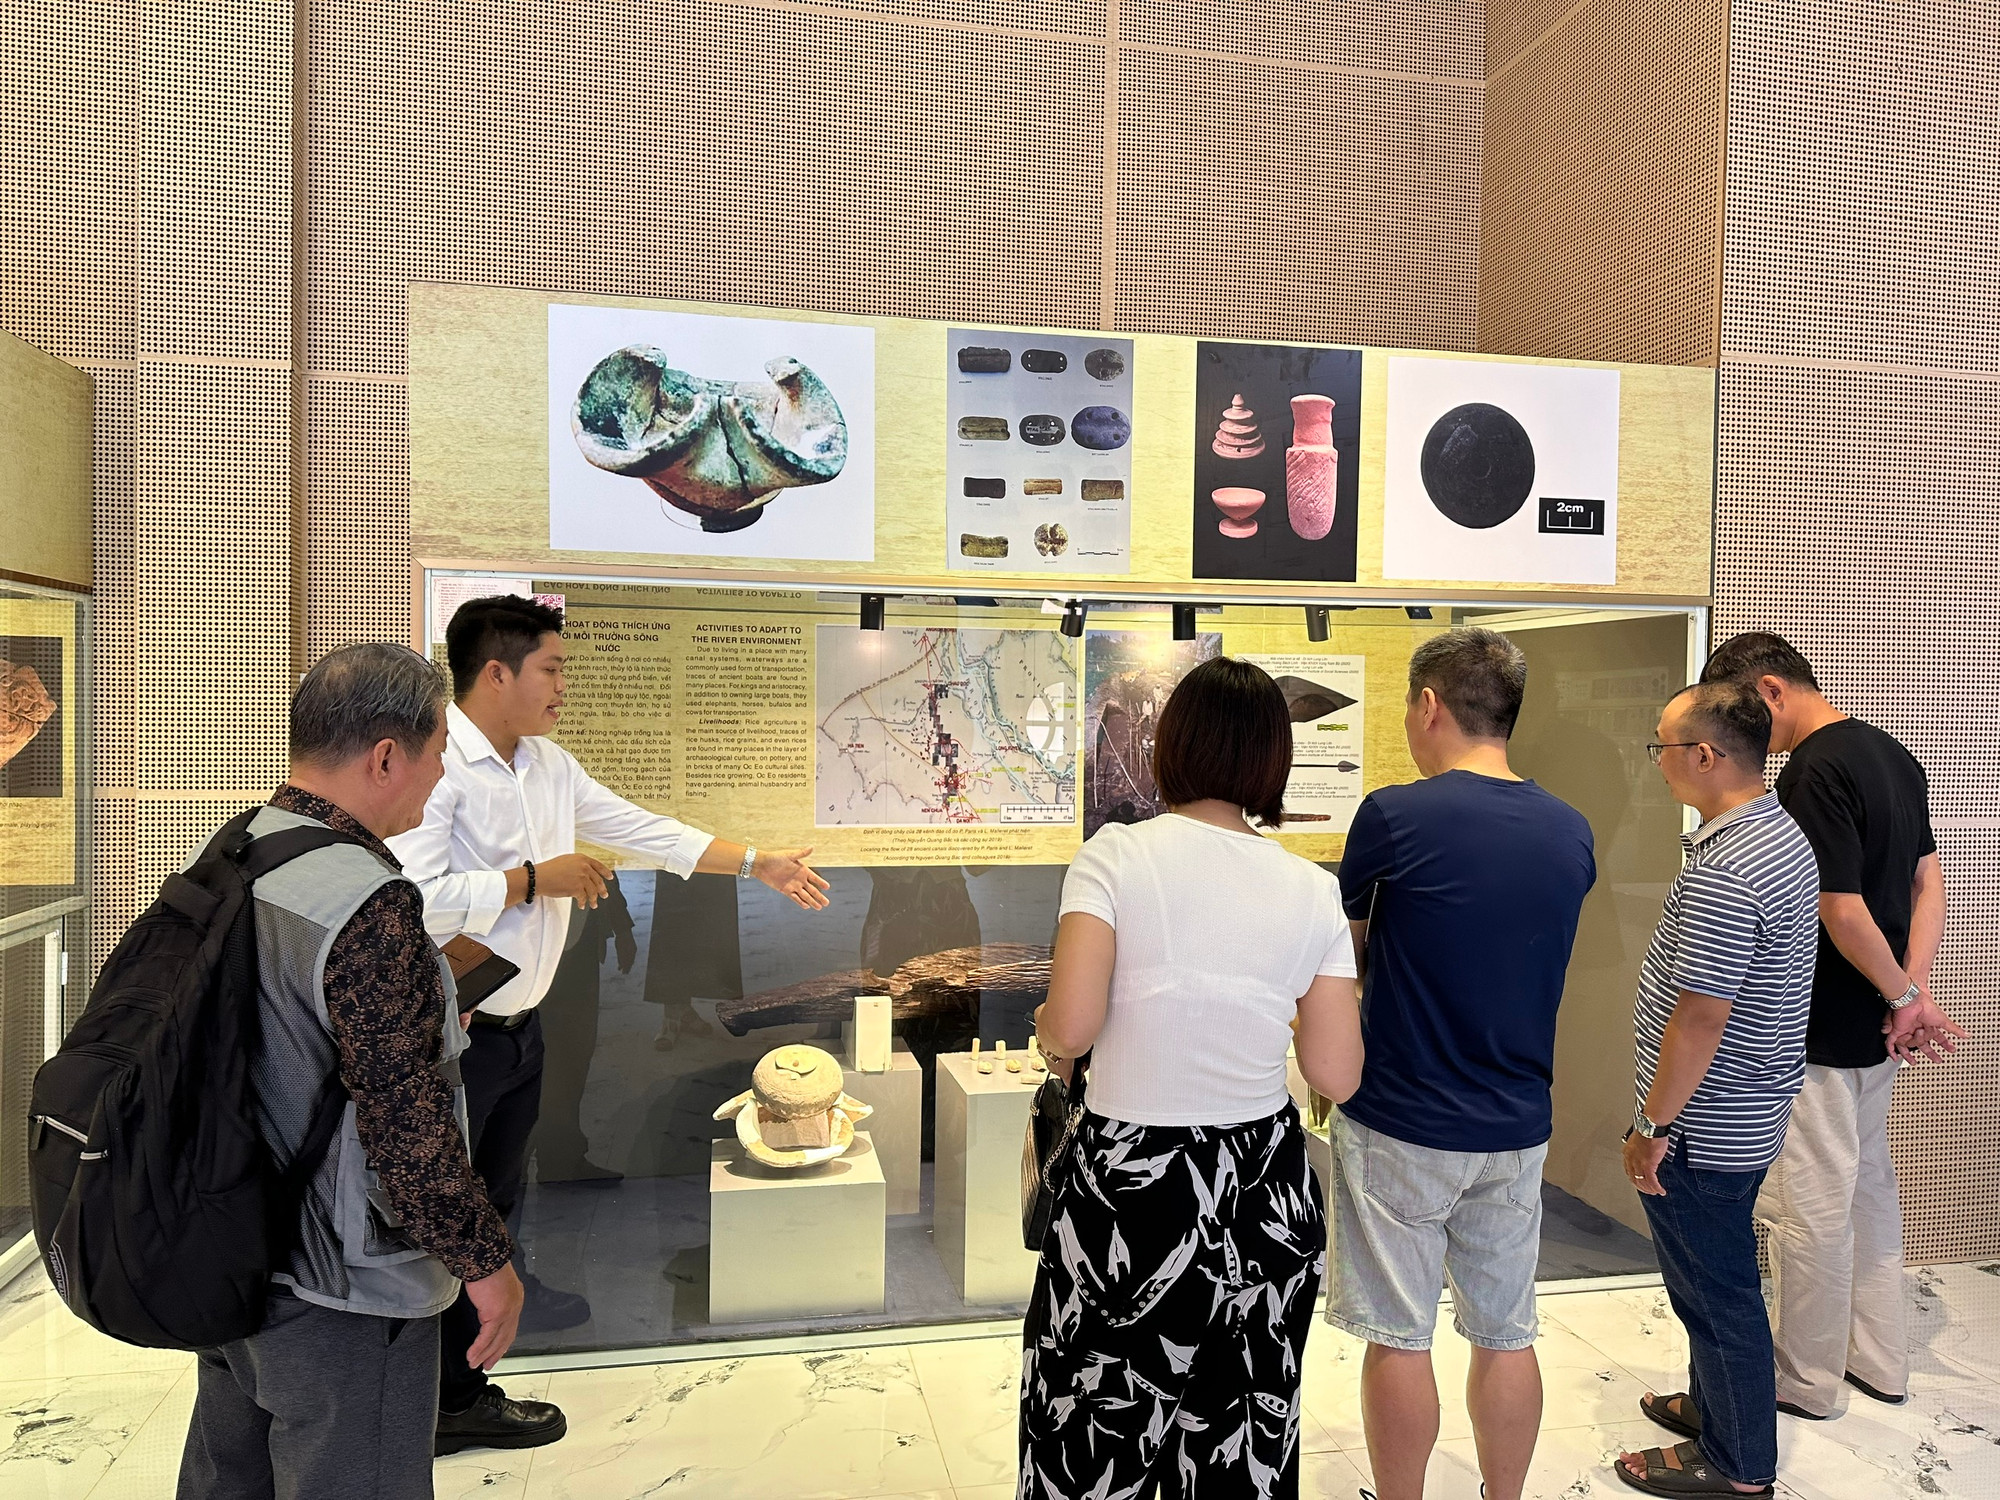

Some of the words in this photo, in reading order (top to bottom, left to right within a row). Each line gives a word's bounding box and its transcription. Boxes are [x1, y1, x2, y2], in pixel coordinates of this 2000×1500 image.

[1557, 502, 1584, 513] 2cm
[565, 620, 590, 628] HOẠT
[592, 619, 619, 629] ĐỘNG
[622, 621, 649, 629] THÍCH
[651, 622, 671, 630] ỨNG
[696, 624, 743, 632] ACTIVITIES
[745, 625, 757, 633] TO
[759, 626, 787, 634] ADAPT
[574, 632, 590, 640] MÔI
[692, 635, 708, 643] THE
[711, 636, 737, 644] RIVER
[740, 637, 801, 645] ENVIRONMENT
[595, 643, 621, 652] NƯỚC
